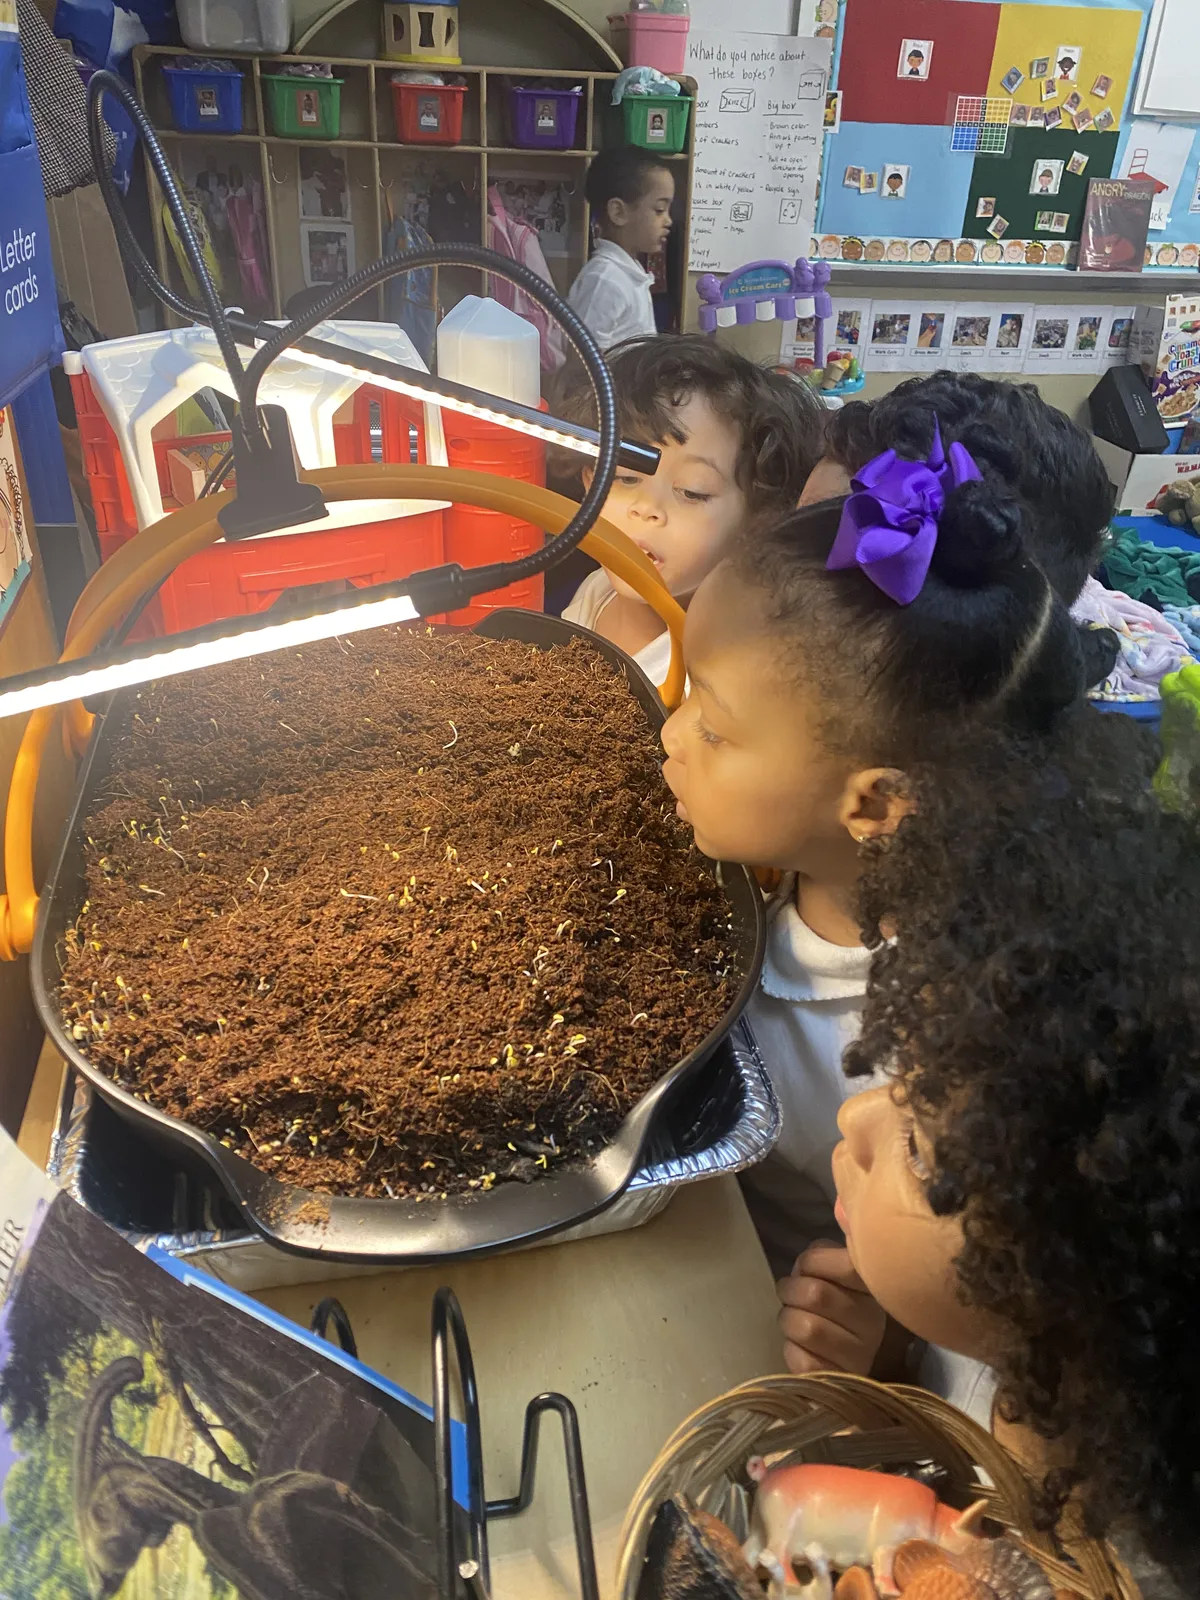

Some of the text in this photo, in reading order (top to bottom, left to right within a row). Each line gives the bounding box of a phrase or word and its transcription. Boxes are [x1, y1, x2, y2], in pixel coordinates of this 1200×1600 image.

[690, 40, 806, 67] What do you notice about
[709, 66, 775, 81] these boxes?
[768, 100, 797, 115] Big box
[1090, 182, 1125, 197] ANGRY
[0, 227, 36, 273] Letter
[5, 267, 38, 315] cards
[740, 284, 764, 293] Cream
[1173, 346, 1199, 361] Toast
[1168, 353, 1200, 373] Crunc
